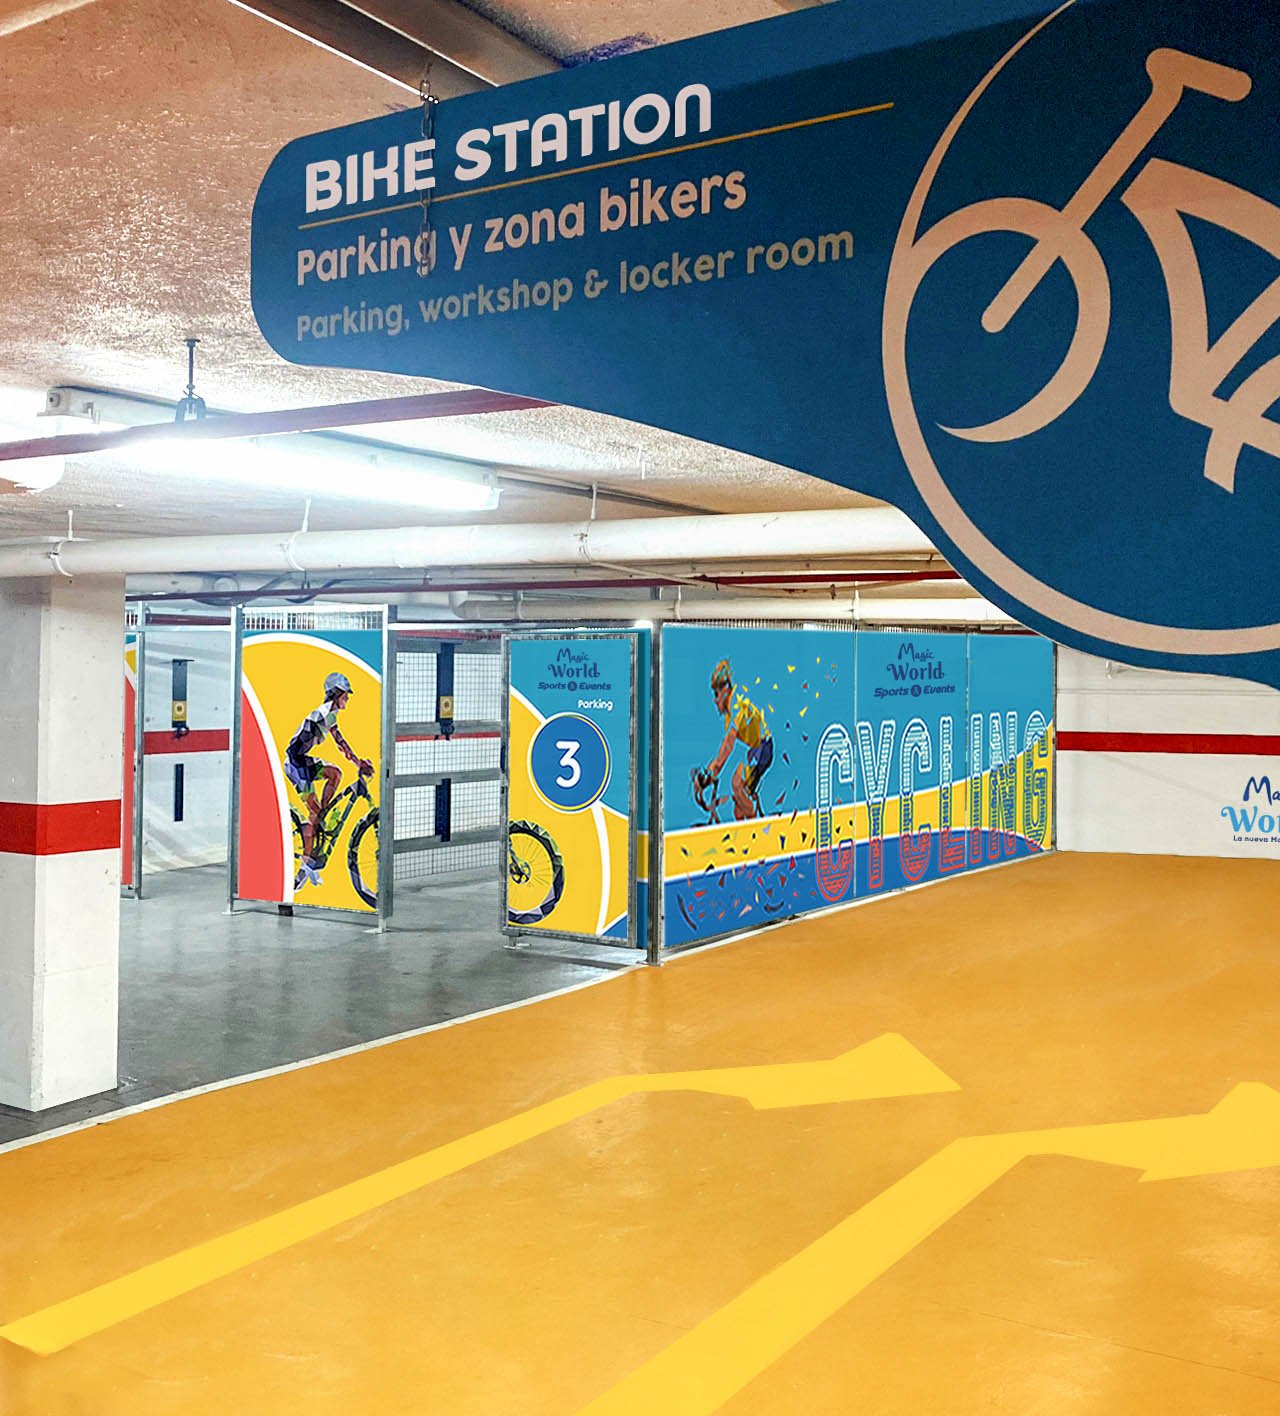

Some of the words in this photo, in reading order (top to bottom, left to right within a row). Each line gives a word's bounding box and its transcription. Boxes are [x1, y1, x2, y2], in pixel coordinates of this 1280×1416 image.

[305, 138, 436, 213] BIKE
[454, 83, 712, 181] STATION
[297, 226, 437, 286] Parking
[449, 222, 472, 270] y
[484, 200, 585, 253] zona
[599, 171, 747, 232] bikers
[296, 301, 411, 342] Parking,
[418, 272, 574, 324] workshop
[583, 268, 609, 299] &
[619, 247, 734, 294] locker
[746, 229, 855, 274] room
[897, 642, 936, 662] Magic
[547, 662, 600, 678] World
[886, 660, 945, 681] World
[538, 681, 567, 692] Sports
[579, 682, 612, 691] Events
[874, 686, 910, 700] Sports
[923, 683, 957, 695] Events
[577, 698, 614, 712] Parking
[555, 740, 581, 788] 3
[816, 710, 1049, 902] CYCLING
